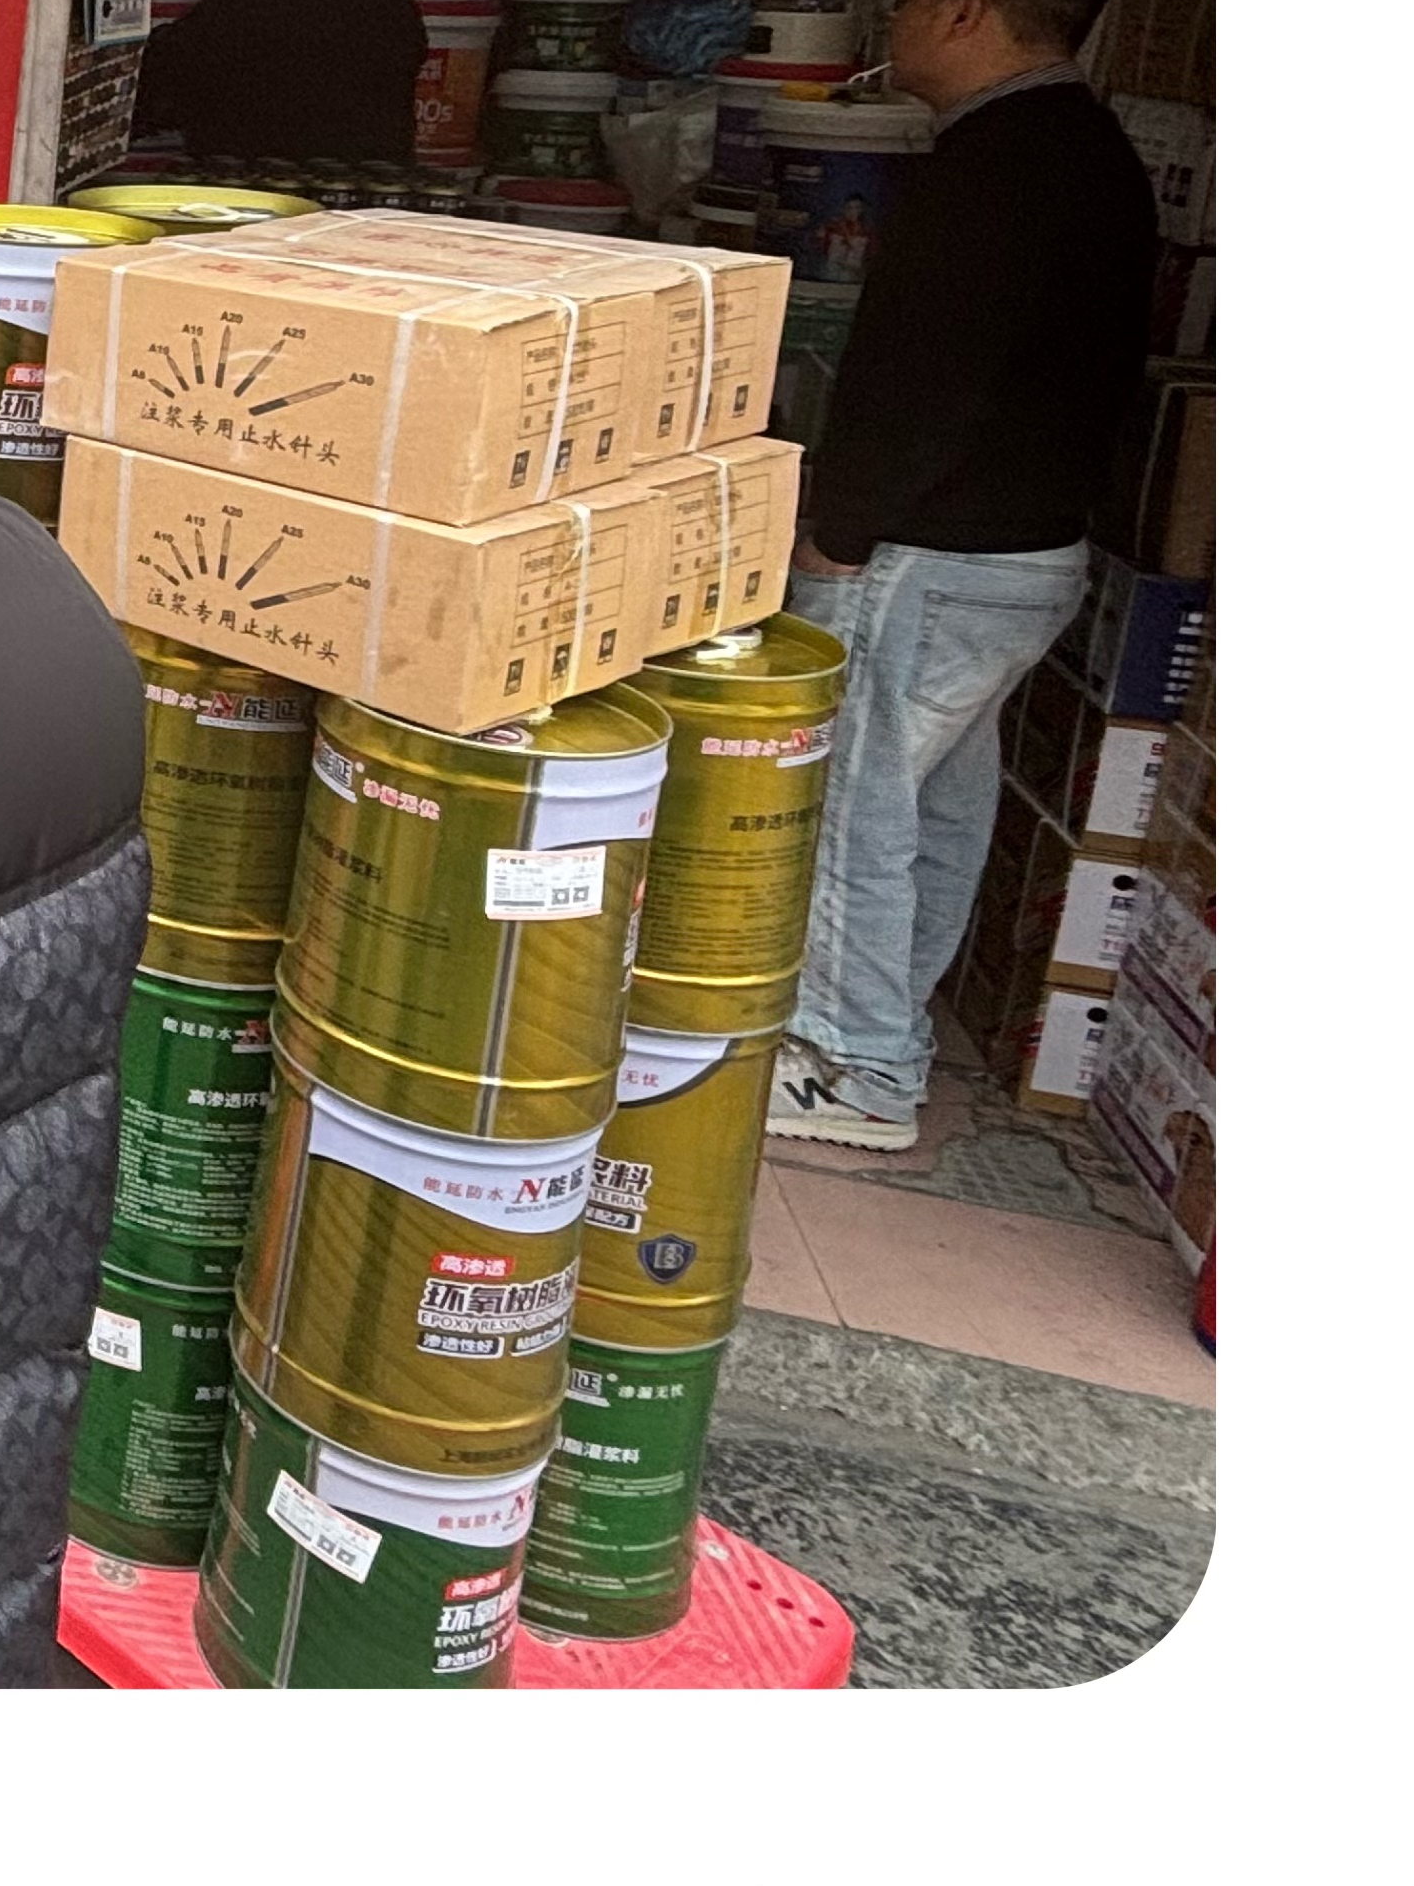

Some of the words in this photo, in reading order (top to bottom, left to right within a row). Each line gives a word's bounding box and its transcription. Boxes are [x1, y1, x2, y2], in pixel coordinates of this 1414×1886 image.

[140, 401, 341, 467] 注浆专用止水针头
[146, 587, 340, 666] 注浆专用止水针头
[423, 1177, 504, 1203] 能延防水
[440, 1255, 507, 1277] 高渗透
